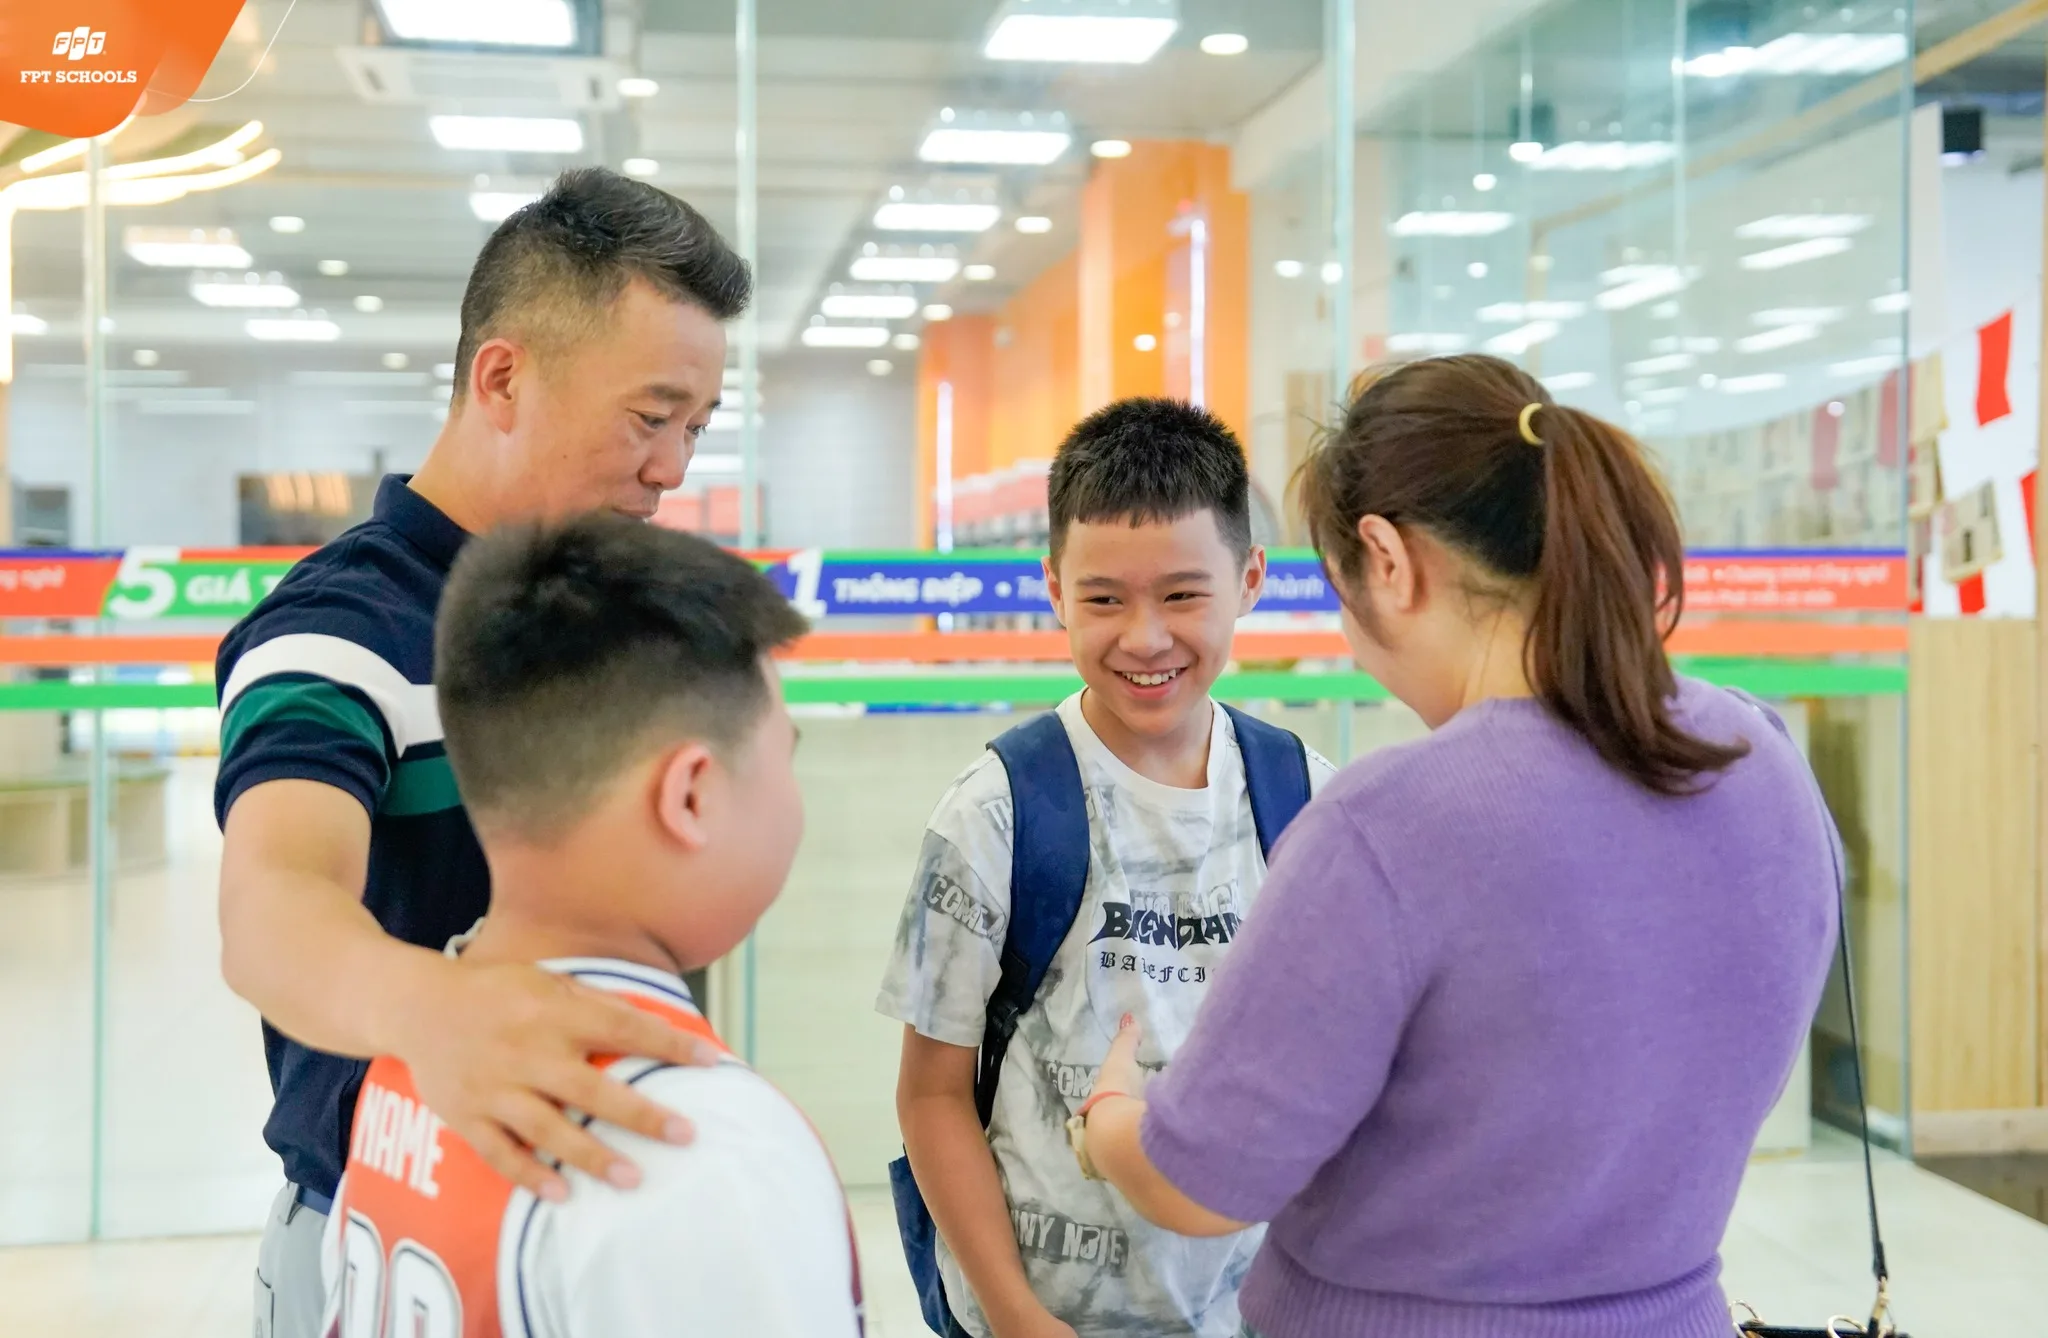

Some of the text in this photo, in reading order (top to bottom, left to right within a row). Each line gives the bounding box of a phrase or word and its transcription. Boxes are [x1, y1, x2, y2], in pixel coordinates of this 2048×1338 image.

[108, 546, 178, 620] 5
[788, 547, 828, 617] 1
[352, 1083, 447, 1199] NAME
